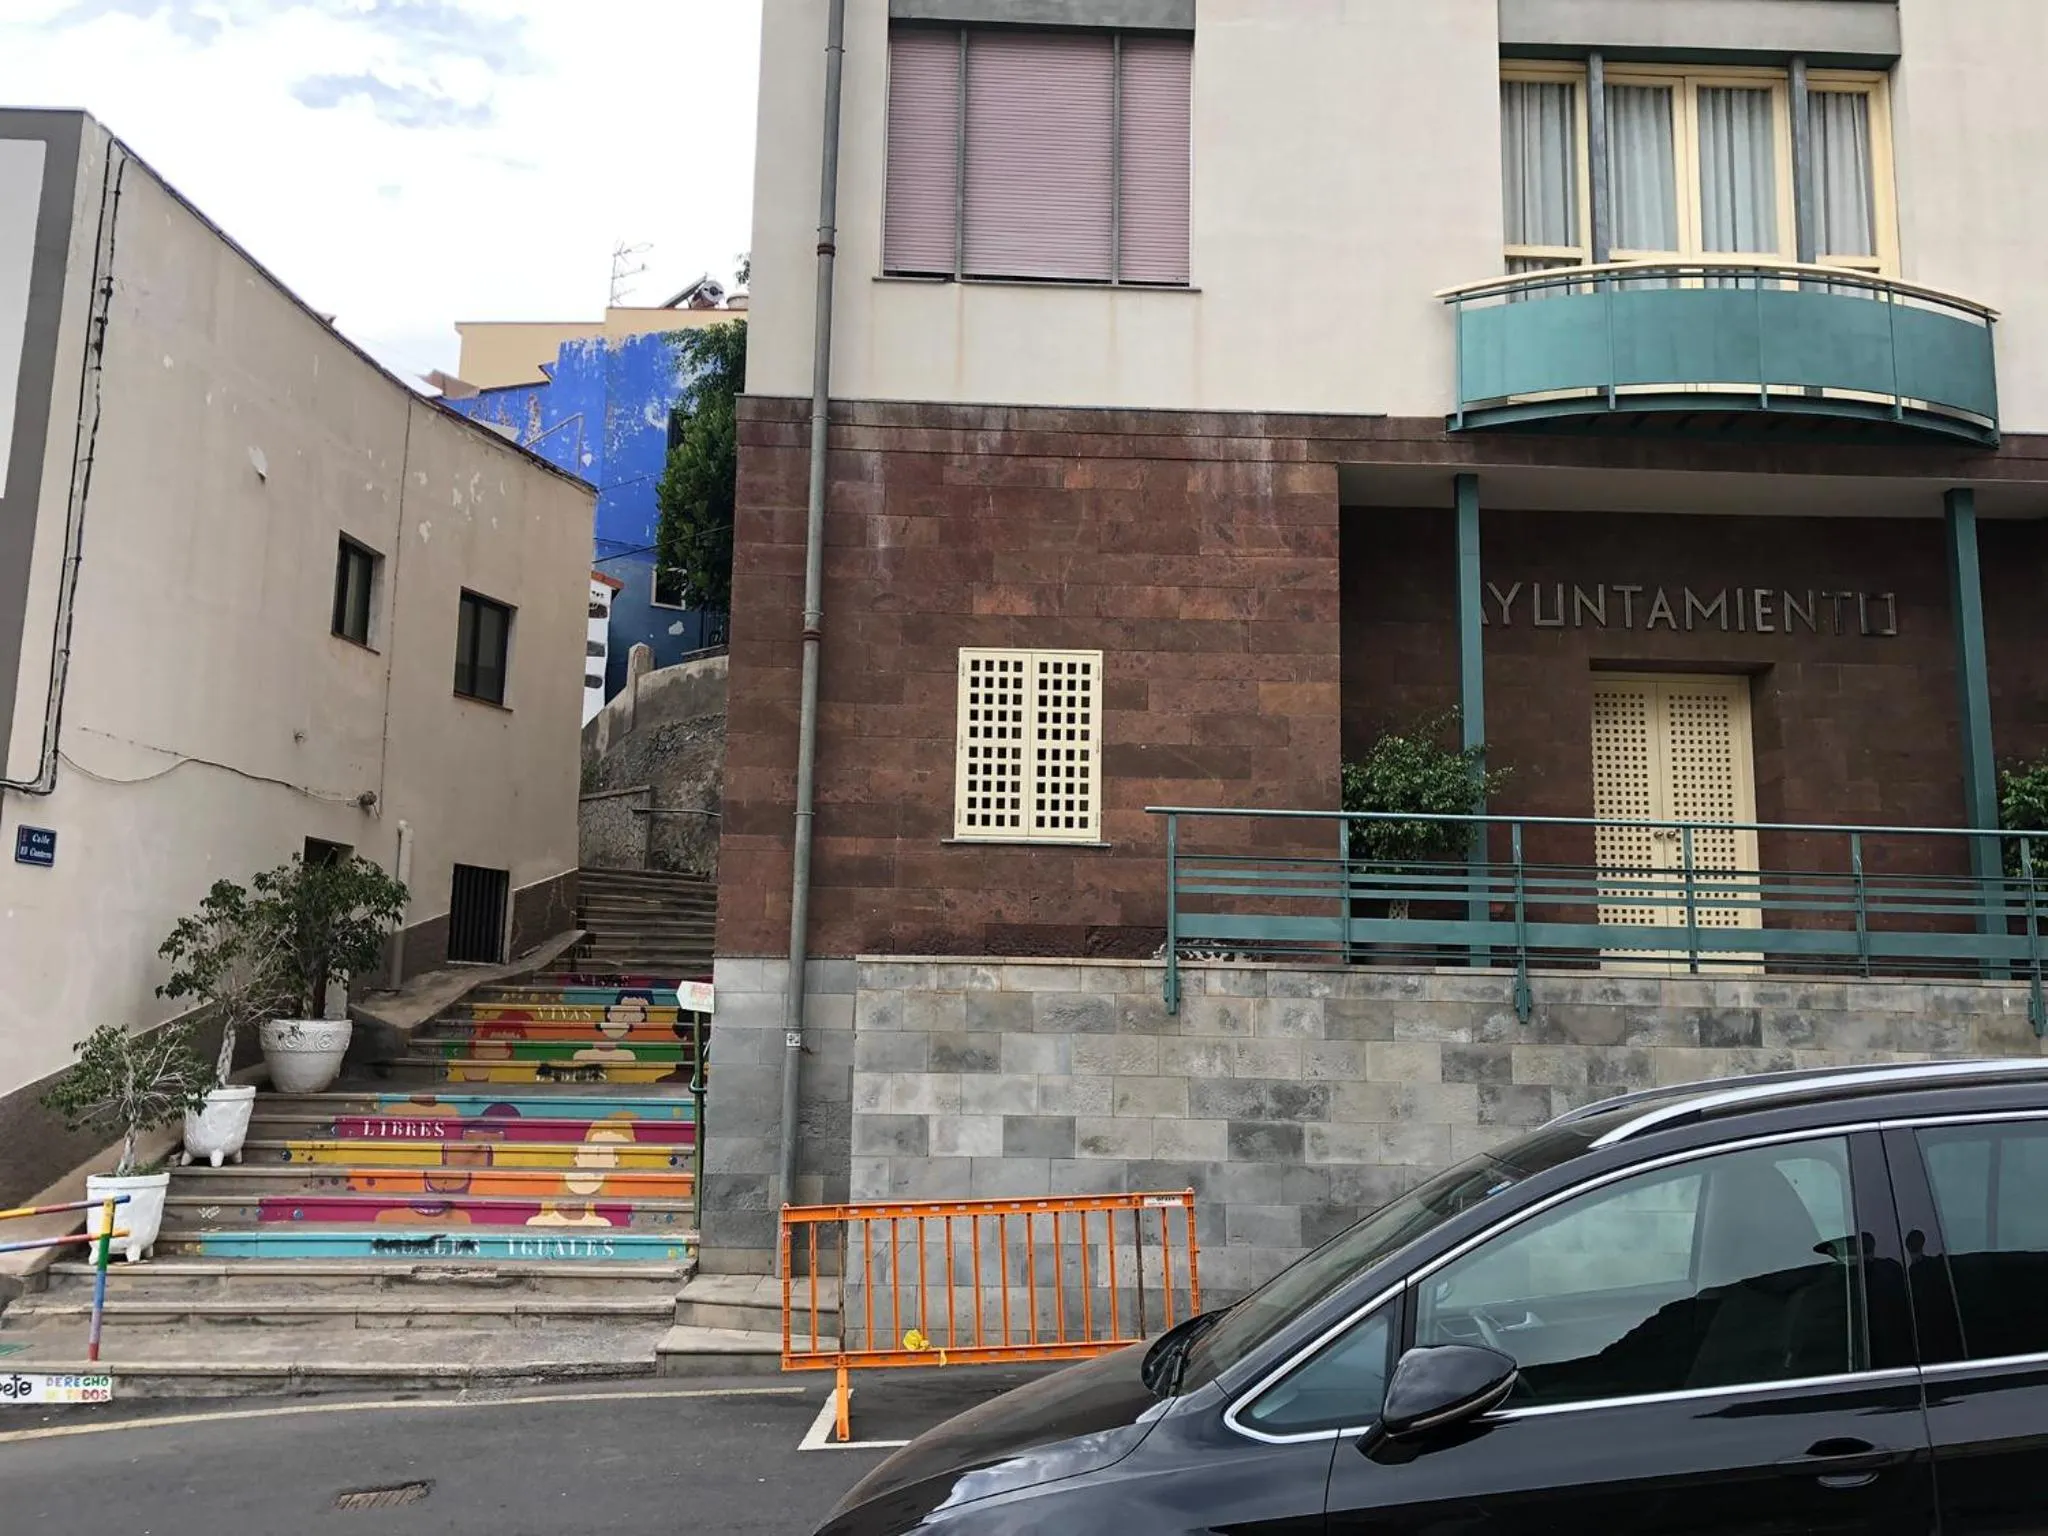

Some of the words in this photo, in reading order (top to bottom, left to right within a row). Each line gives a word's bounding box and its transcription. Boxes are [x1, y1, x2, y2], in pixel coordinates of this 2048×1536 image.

[1480, 580, 1898, 636] YUNTAMIENTO
[537, 1007, 592, 1021] VIVAS
[363, 1120, 445, 1137] LIBRES
[507, 1238, 615, 1257] IGUALES
[46, 1376, 109, 1387] DERECHO
